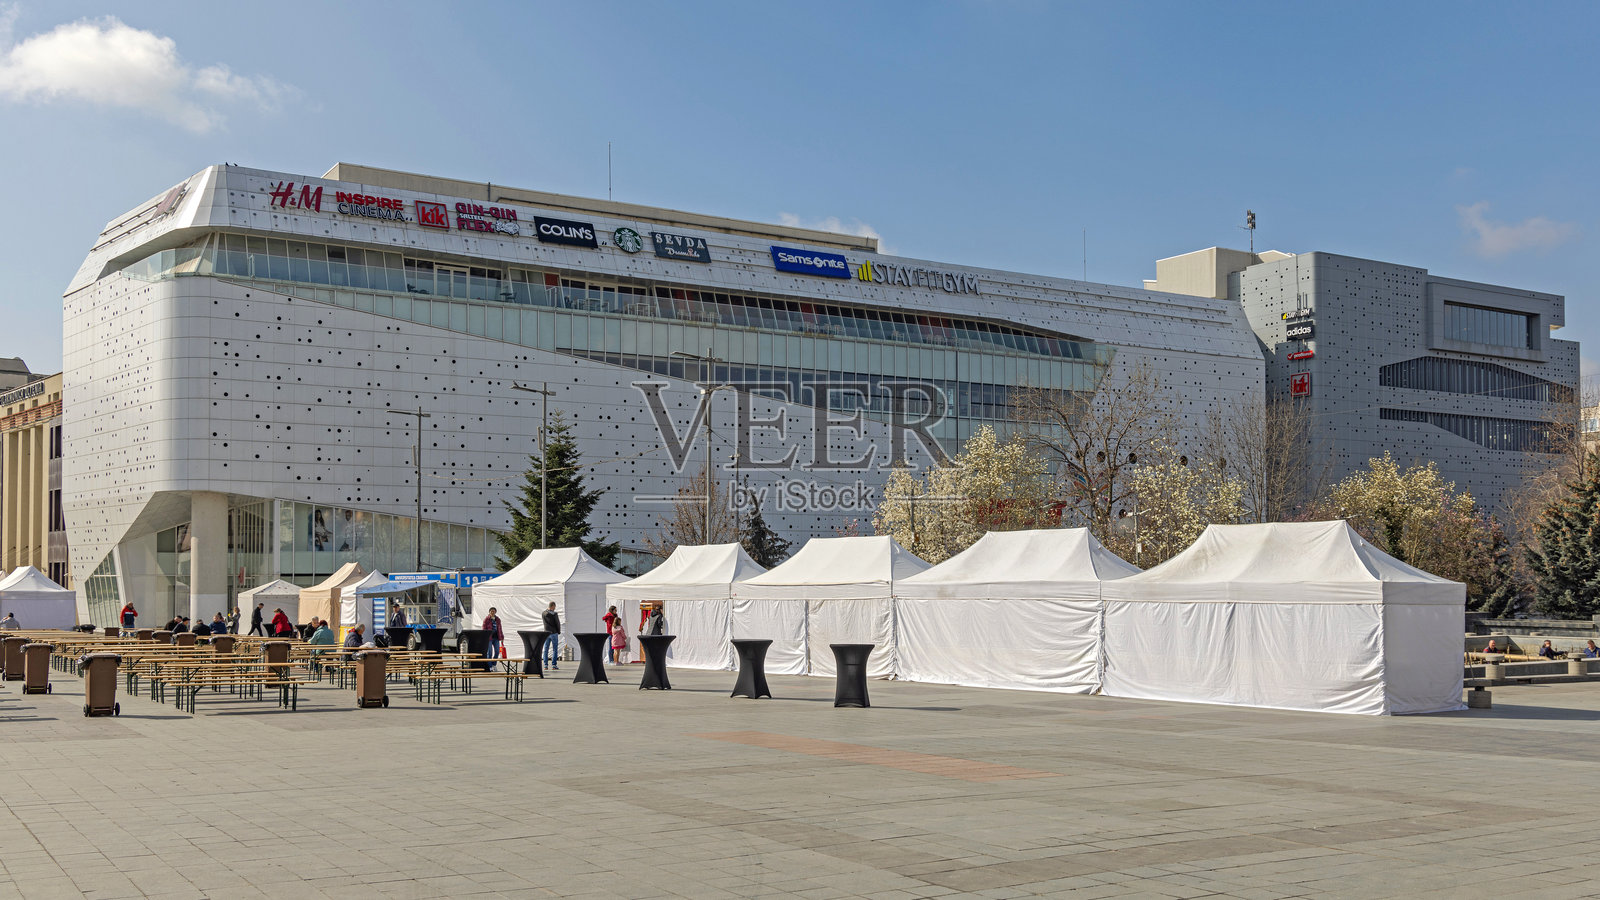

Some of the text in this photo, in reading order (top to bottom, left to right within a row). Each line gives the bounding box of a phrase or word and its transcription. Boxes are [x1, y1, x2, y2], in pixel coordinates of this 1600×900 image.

[269, 181, 323, 213] H&M
[336, 191, 404, 211] INSPIRE
[456, 202, 518, 221] GIN-GIN
[456, 217, 495, 232] FLEX
[539, 223, 593, 240] COLIN'S
[655, 233, 706, 249] SEVDA
[777, 252, 845, 270] Samsonite
[1286, 326, 1312, 337] adidas
